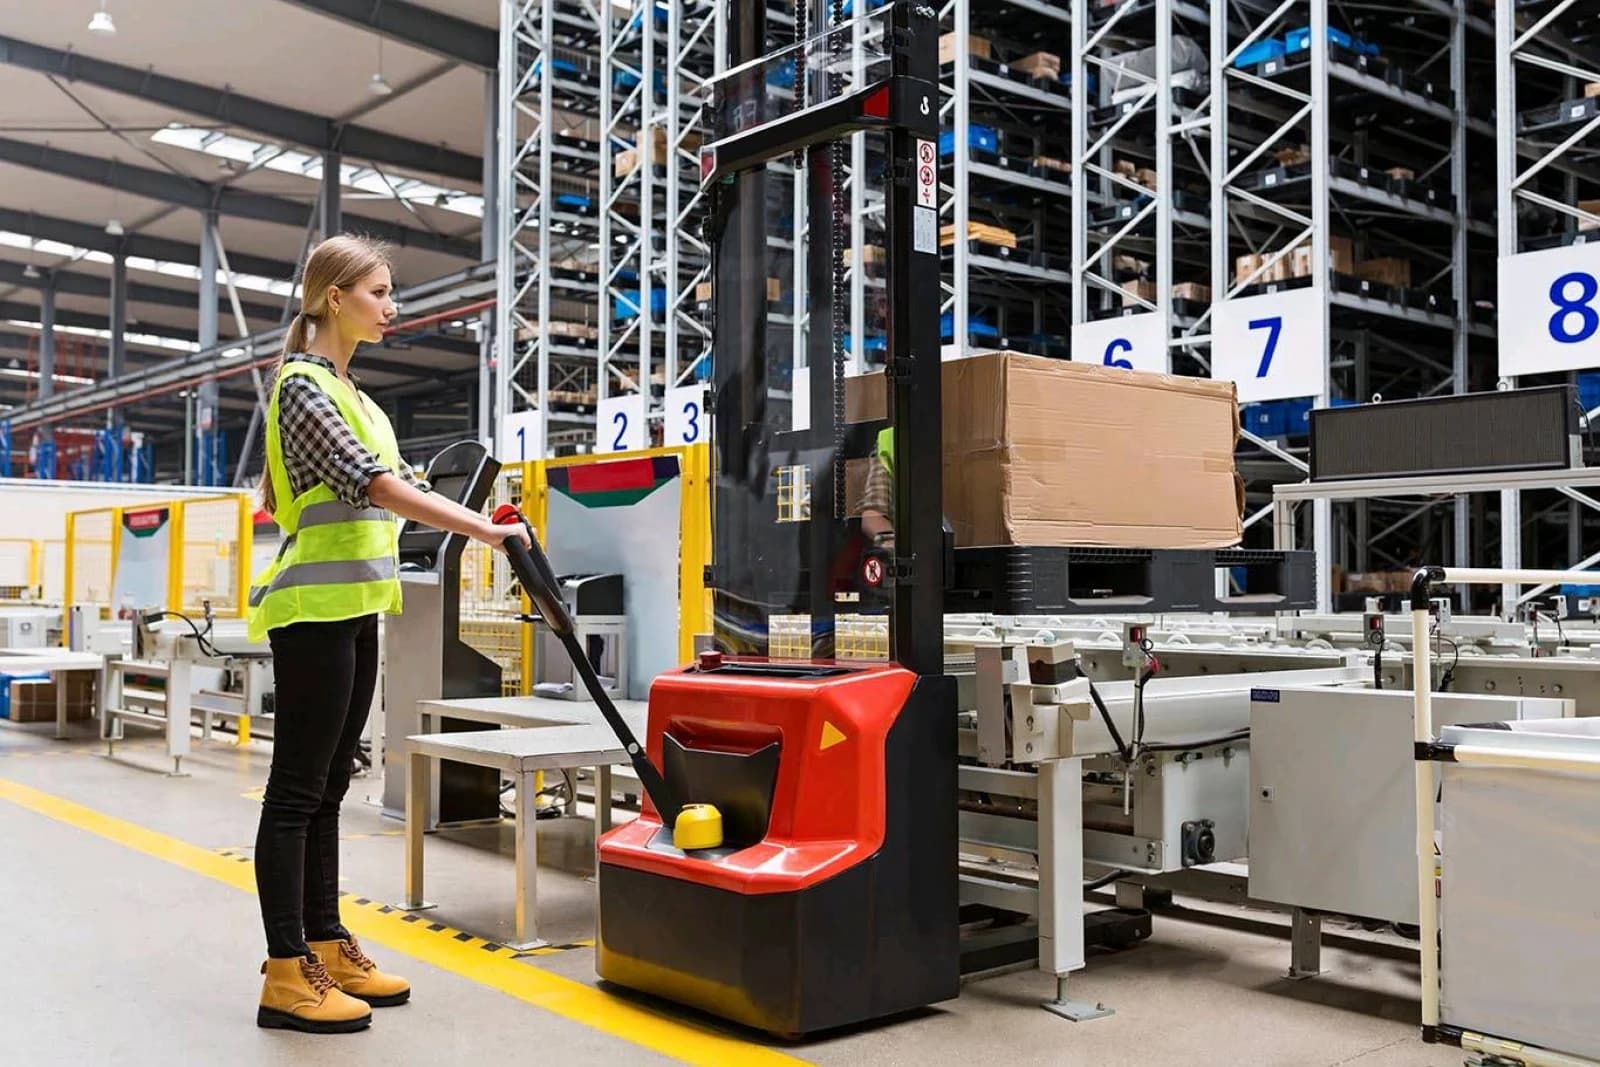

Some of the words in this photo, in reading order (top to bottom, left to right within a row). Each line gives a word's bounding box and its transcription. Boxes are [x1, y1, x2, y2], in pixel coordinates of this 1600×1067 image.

[1547, 271, 1600, 345] 8
[1247, 315, 1284, 379] 7
[515, 426, 525, 460] 1
[611, 411, 629, 451] 2
[682, 401, 700, 443] 3
